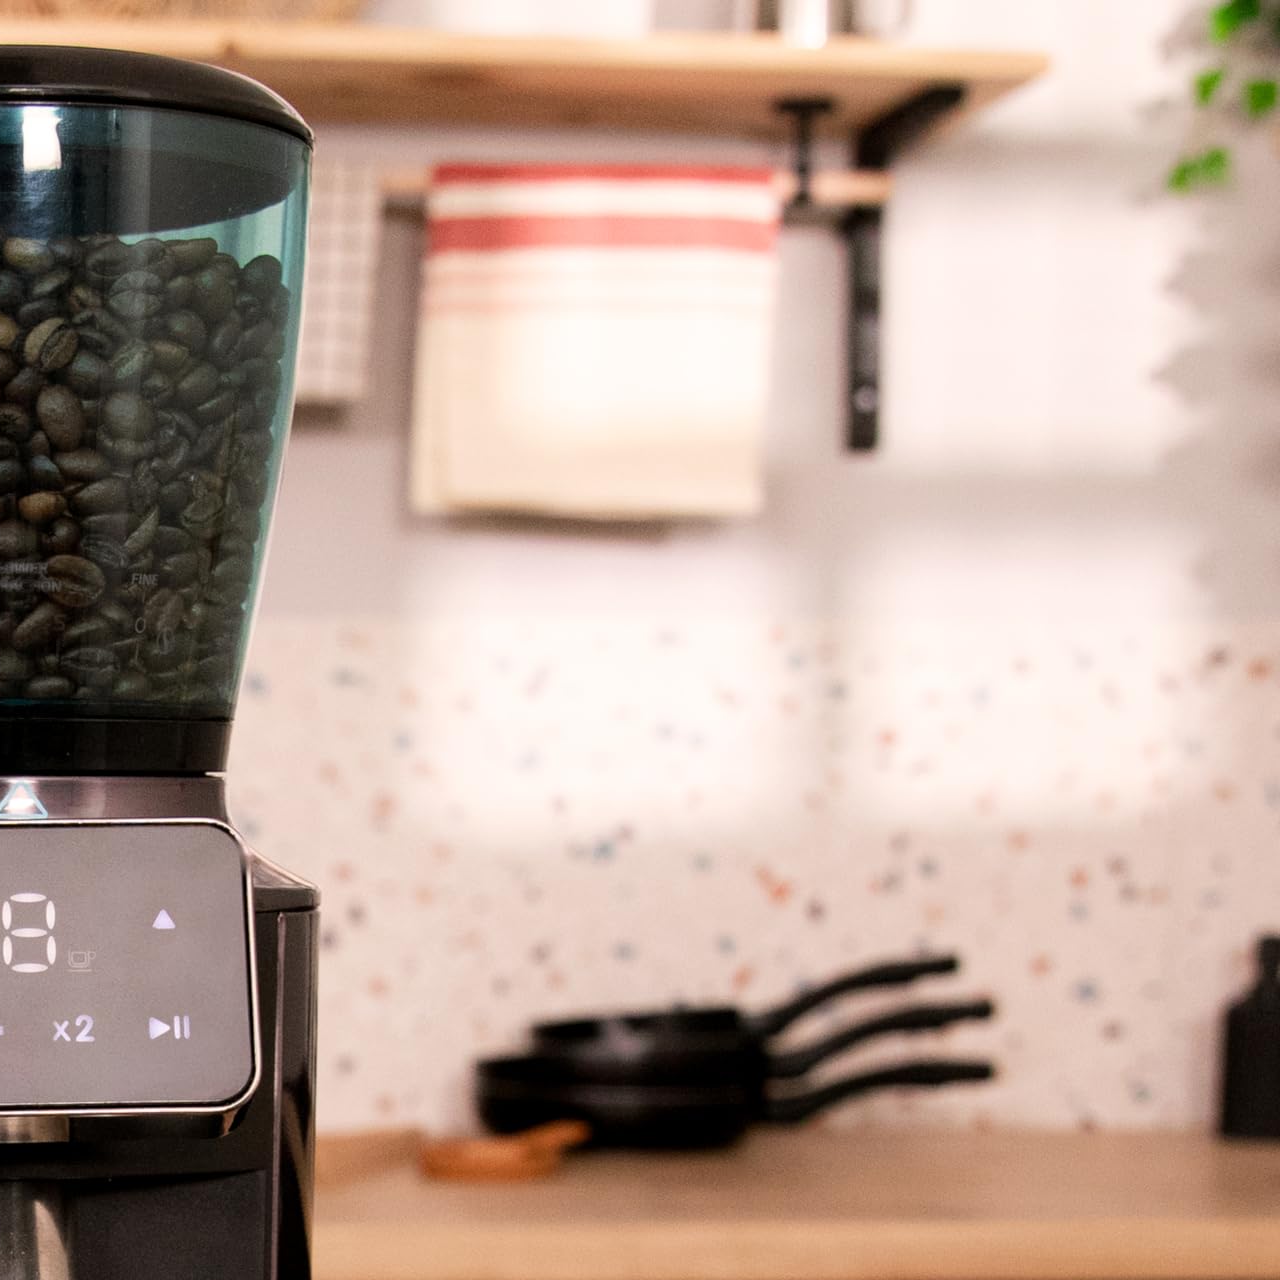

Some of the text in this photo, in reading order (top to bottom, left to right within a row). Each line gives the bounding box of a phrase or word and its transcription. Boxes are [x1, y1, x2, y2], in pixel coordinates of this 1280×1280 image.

[131, 573, 159, 586] FINE
[2, 892, 56, 973] 8
[52, 1014, 96, 1042] x2
